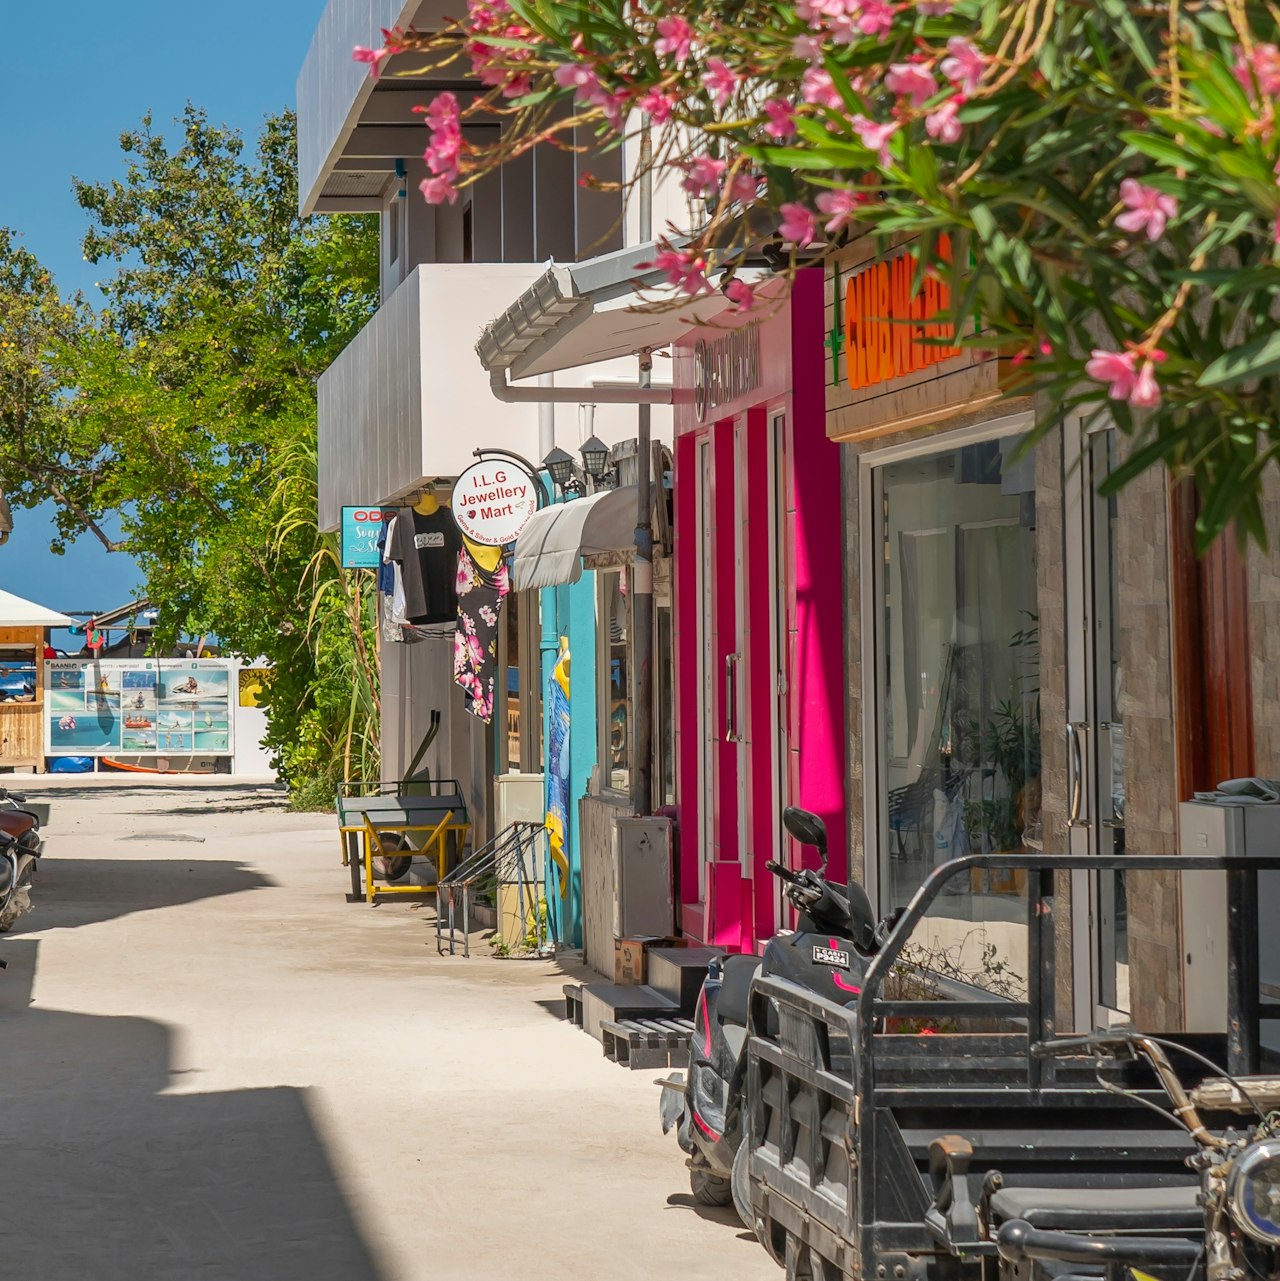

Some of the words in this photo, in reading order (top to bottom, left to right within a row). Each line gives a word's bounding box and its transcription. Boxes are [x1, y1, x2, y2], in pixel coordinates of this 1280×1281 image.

[473, 471, 507, 488] I.L.G
[460, 485, 526, 507] Jewellery
[481, 504, 513, 520] Mart
[457, 514, 469, 532] Gems
[475, 532, 492, 543] Silver
[500, 534, 514, 543] Gold
[415, 533, 444, 548] 2022
